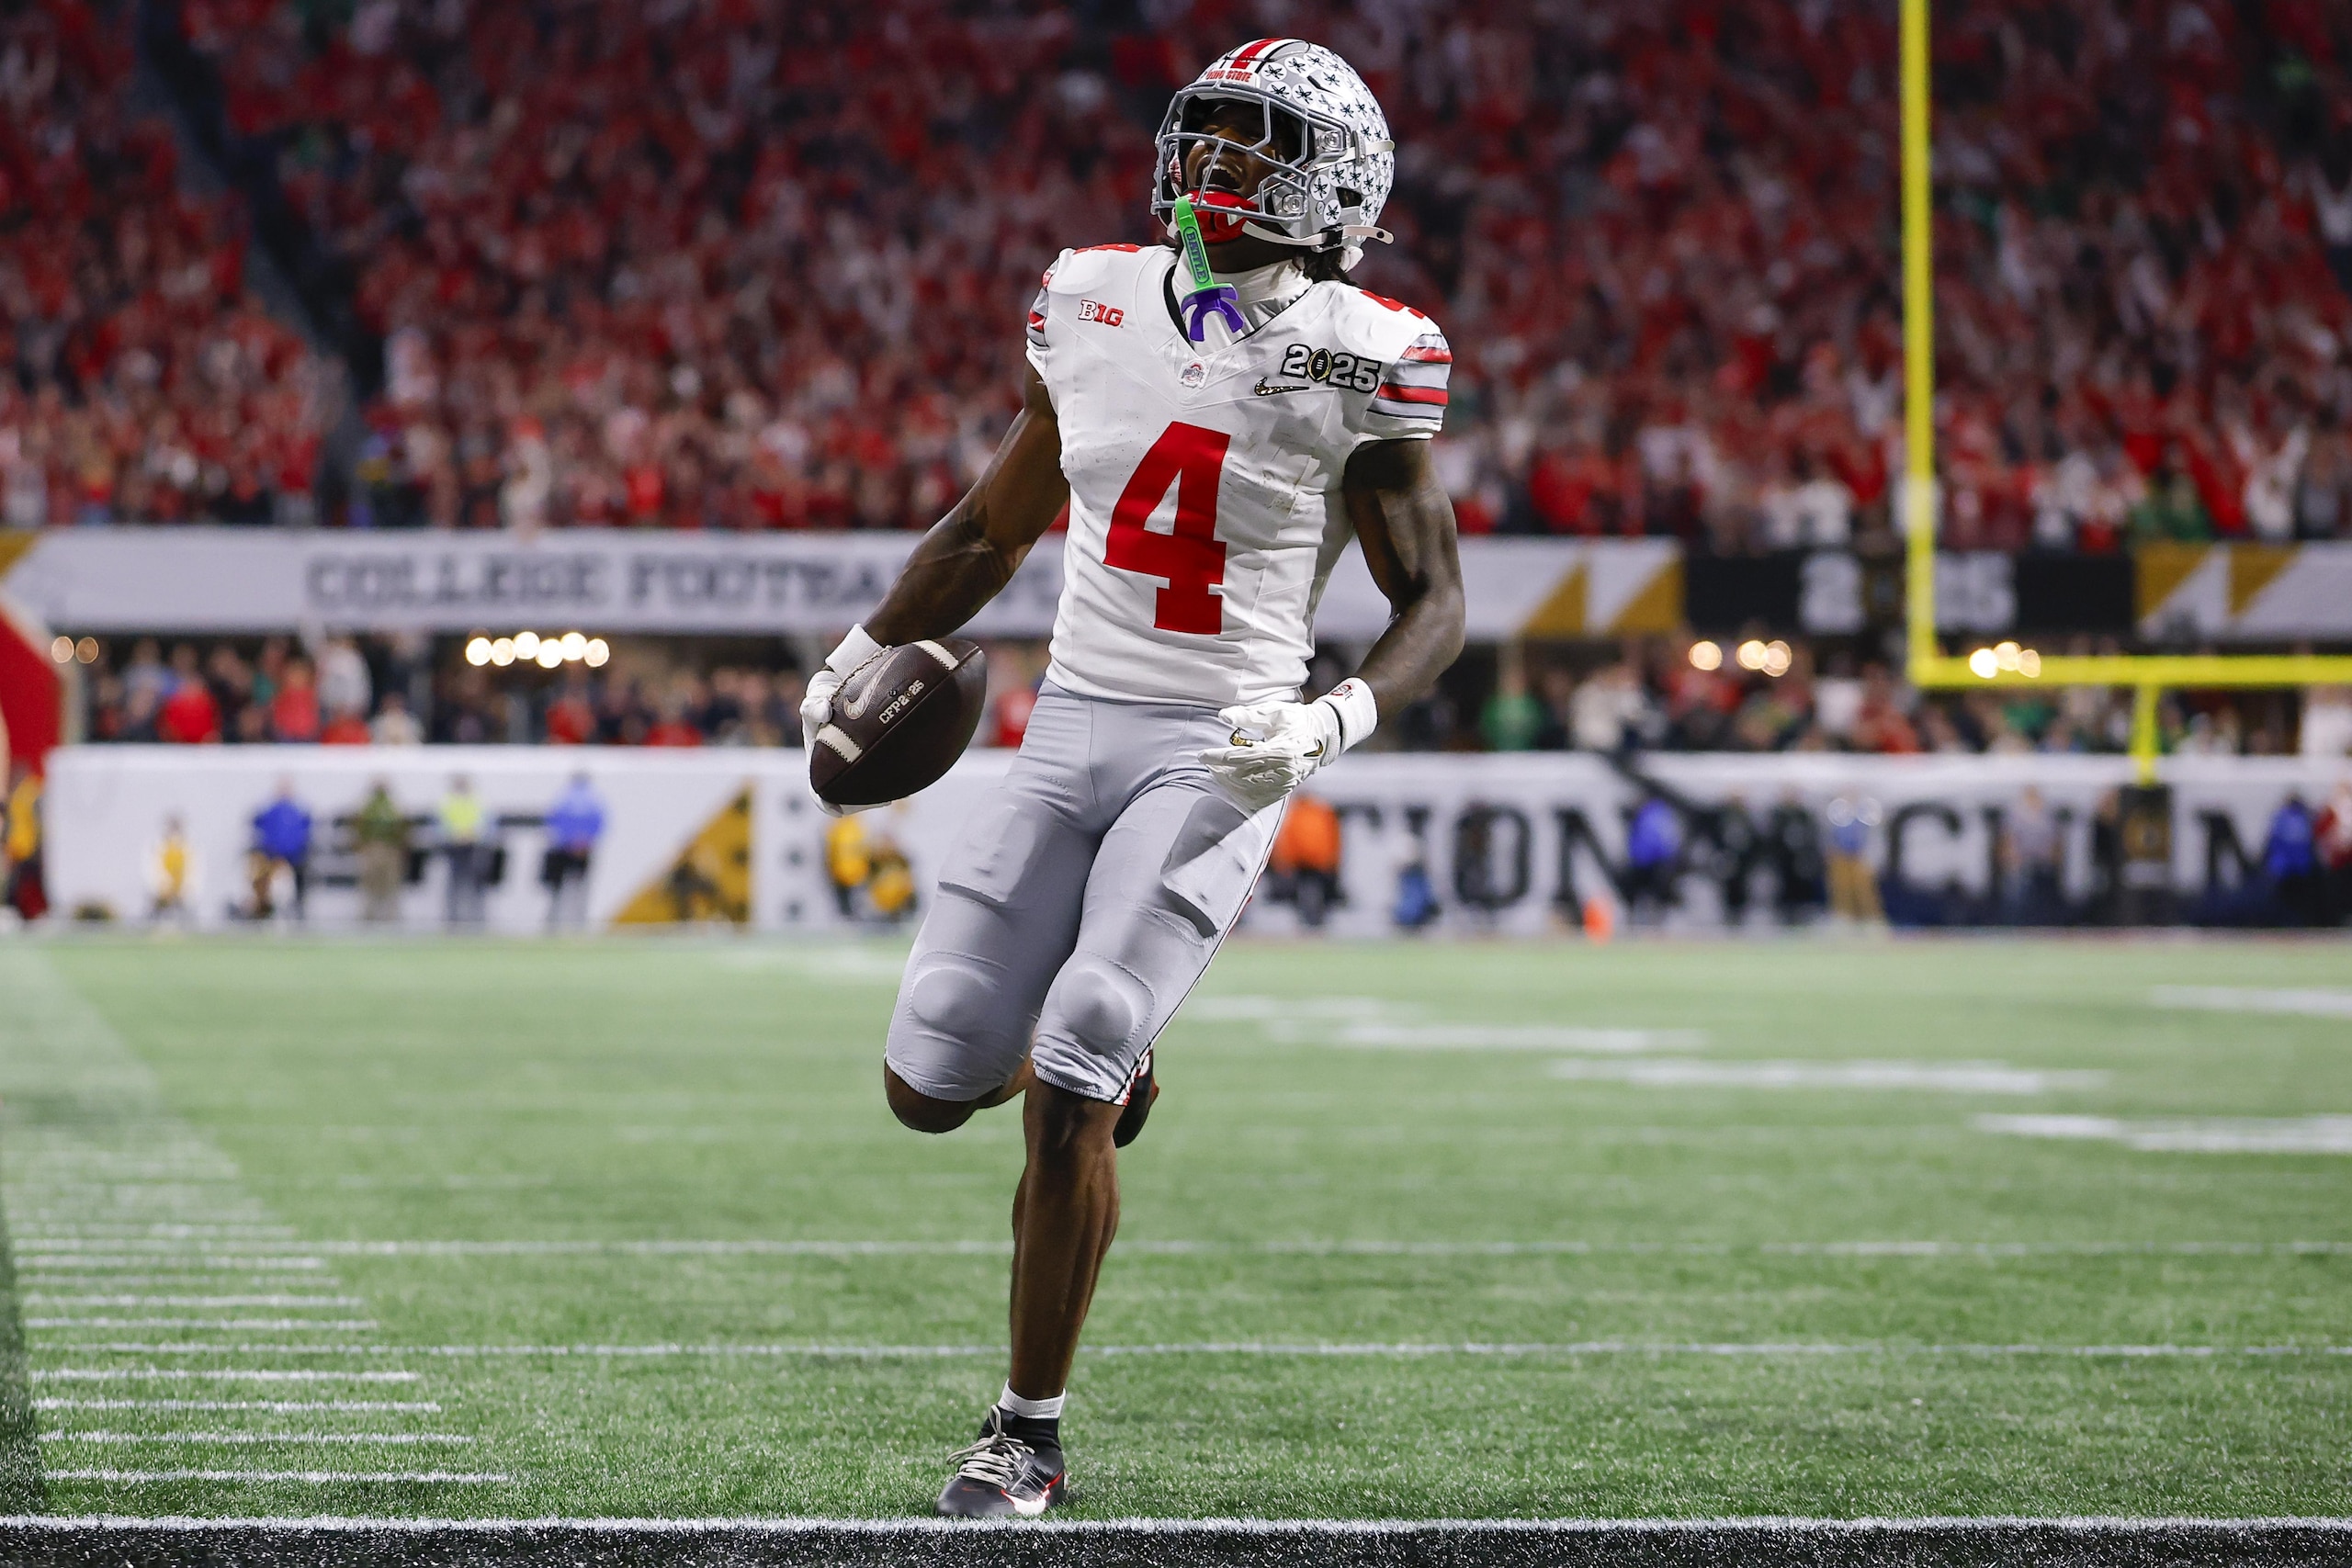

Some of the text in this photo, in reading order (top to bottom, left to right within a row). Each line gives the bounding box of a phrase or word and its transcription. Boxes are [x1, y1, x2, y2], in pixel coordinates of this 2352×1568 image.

[1226, 70, 1253, 83] STATE
[1280, 343, 1382, 394] 2025
[1102, 421, 1231, 635] 4
